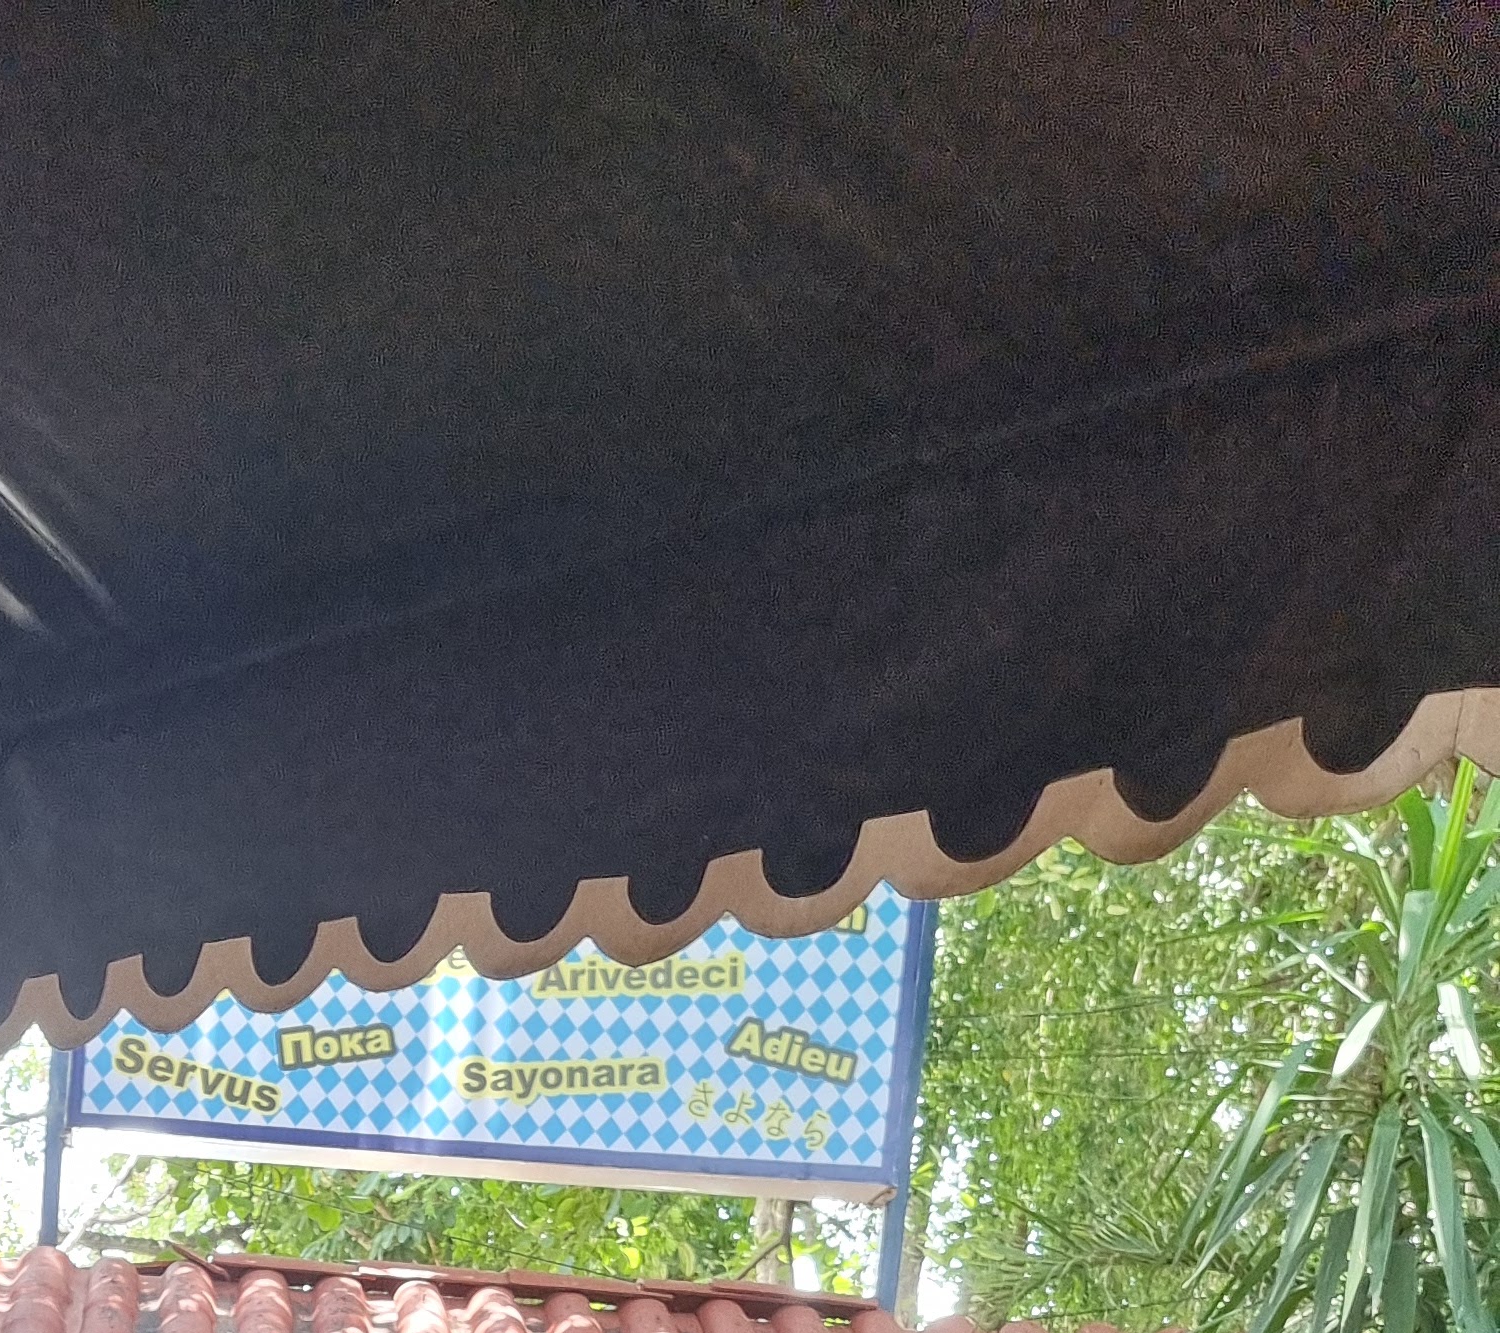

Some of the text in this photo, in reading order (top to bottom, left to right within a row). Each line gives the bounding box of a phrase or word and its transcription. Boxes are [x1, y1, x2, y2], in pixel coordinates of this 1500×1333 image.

[537, 957, 738, 991] Arivedeci
[278, 1025, 395, 1069] Пока
[728, 1019, 856, 1084] Adieu
[115, 1037, 278, 1112] Servus
[462, 1061, 661, 1099] Sayonara
[688, 1082, 828, 1147] さよなら
